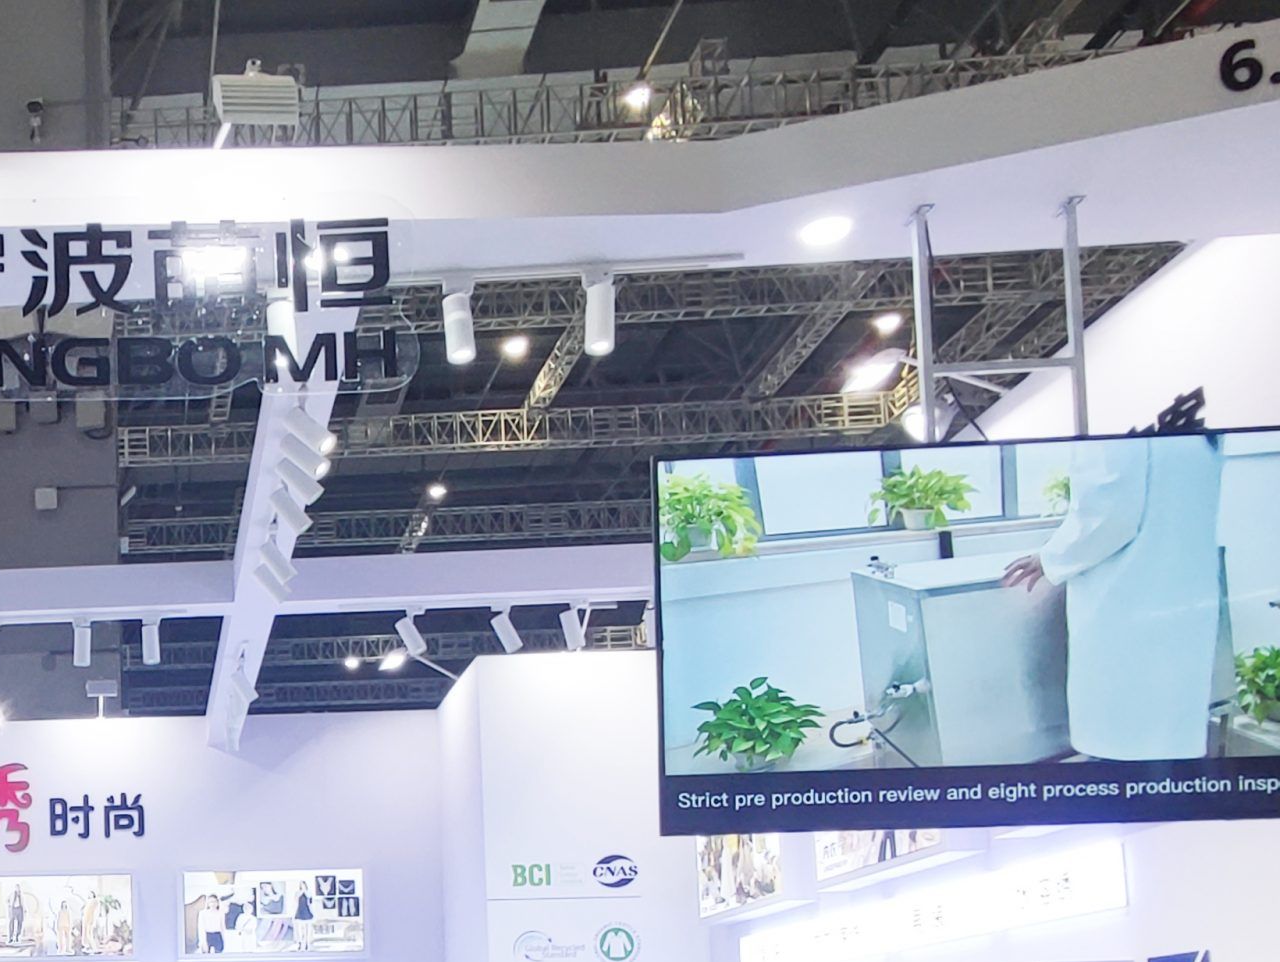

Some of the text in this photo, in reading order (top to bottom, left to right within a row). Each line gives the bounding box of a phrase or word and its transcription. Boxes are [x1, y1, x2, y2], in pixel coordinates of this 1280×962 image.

[266, 329, 397, 383] MH
[677, 775, 1280, 811] Strict pre production review and eight process production insp
[512, 863, 552, 887] BCI
[592, 865, 638, 878] CNAS
